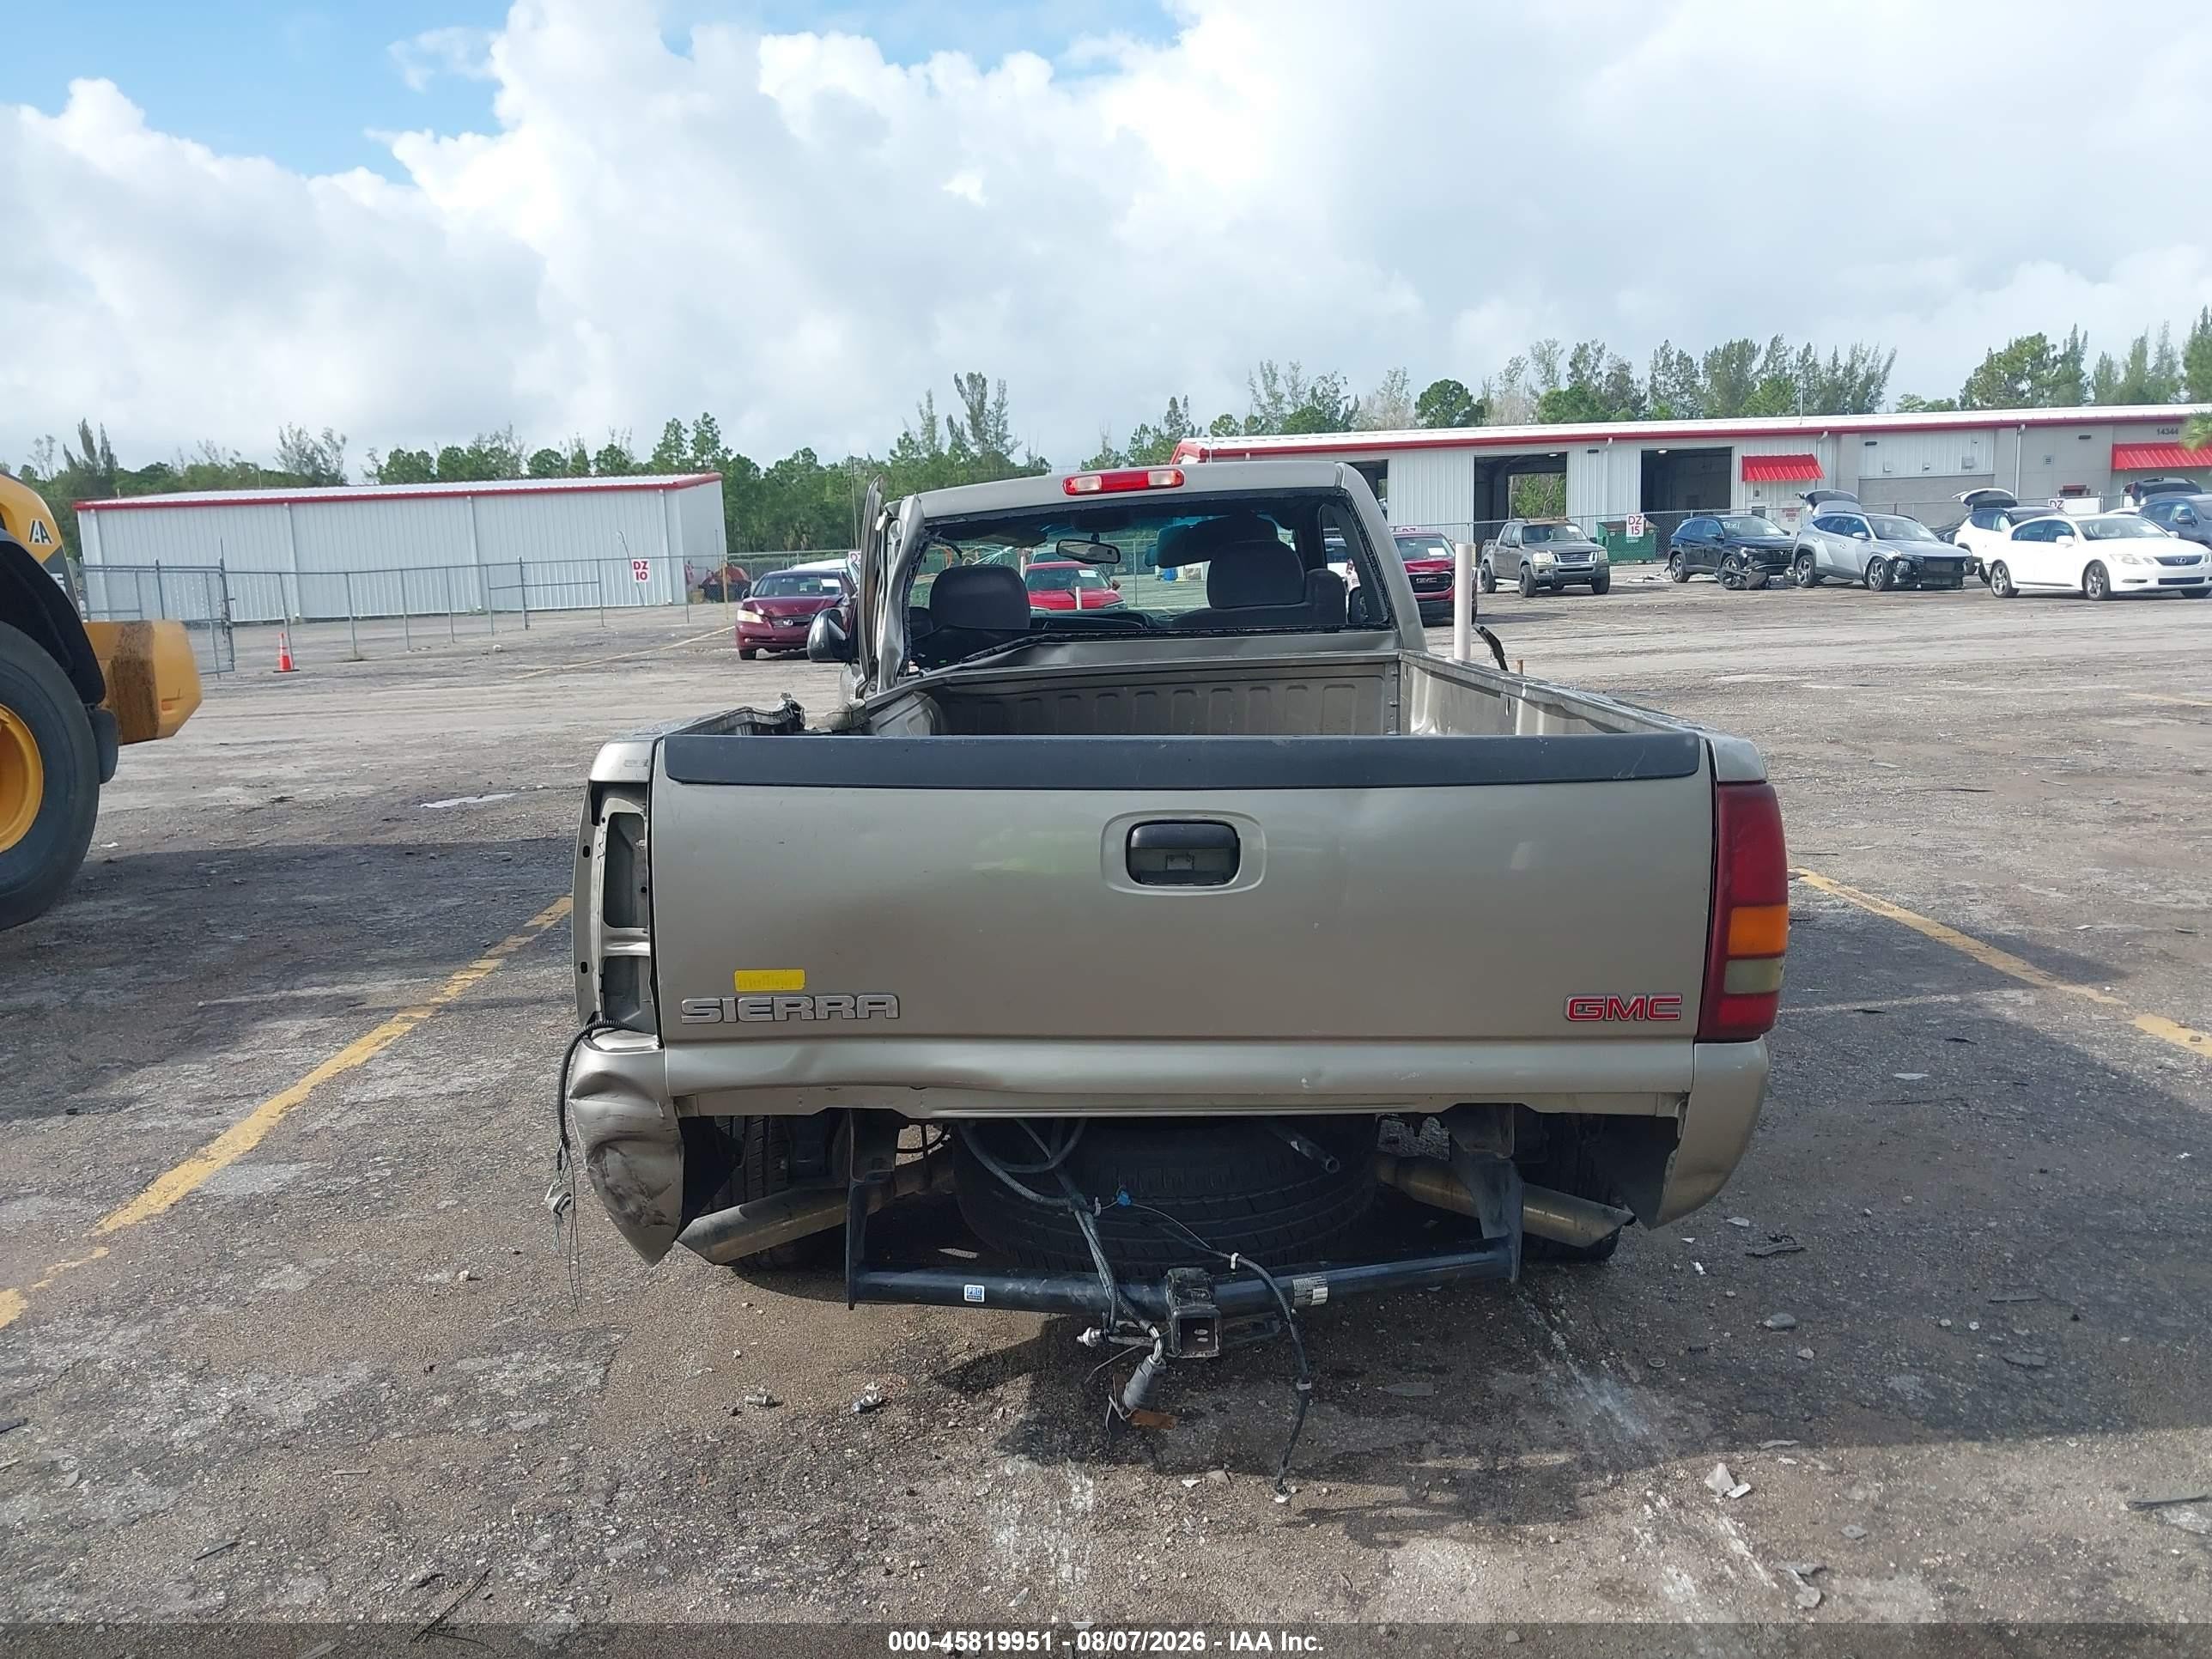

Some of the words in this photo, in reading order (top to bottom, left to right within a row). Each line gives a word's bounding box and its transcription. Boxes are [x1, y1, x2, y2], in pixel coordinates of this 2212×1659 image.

[1628, 515, 1642, 525] DZ
[1632, 526, 1640, 535] 15
[633, 561, 648, 570] DZ
[635, 571, 647, 580] 10
[681, 994, 900, 1024] SIERRA
[1565, 994, 1682, 1021] GMC
